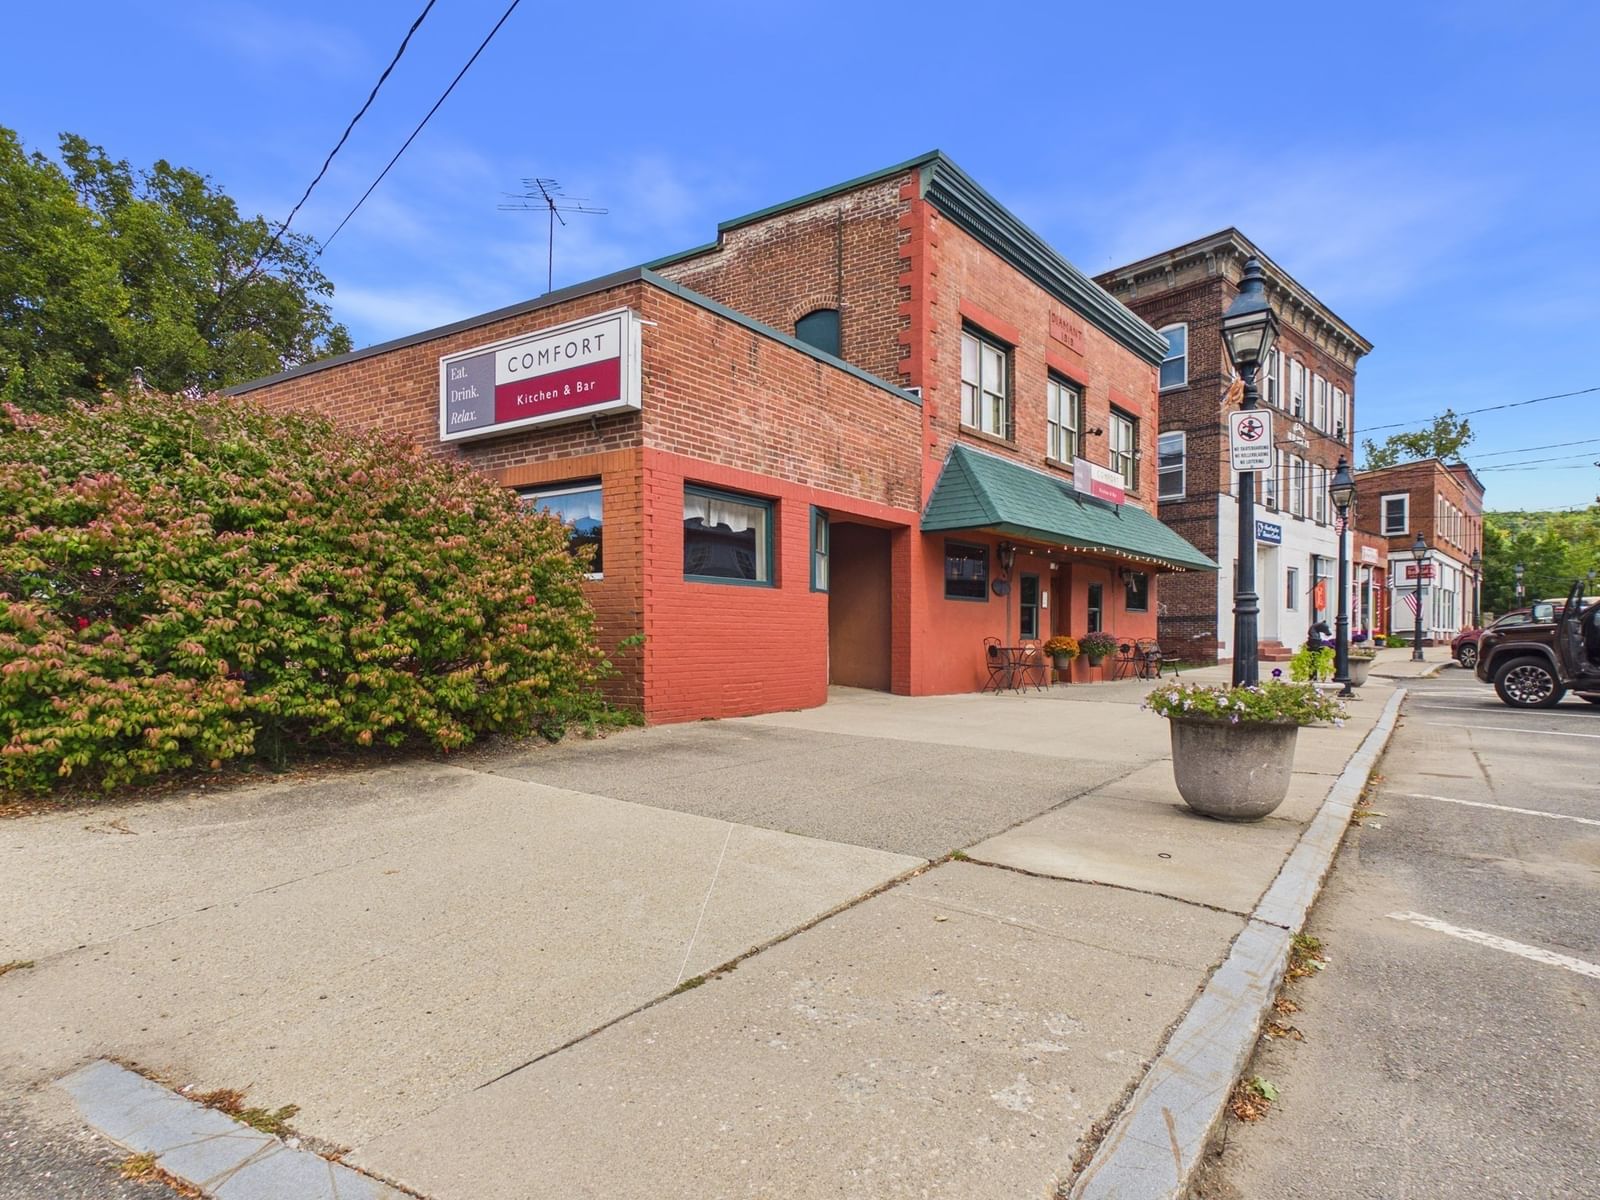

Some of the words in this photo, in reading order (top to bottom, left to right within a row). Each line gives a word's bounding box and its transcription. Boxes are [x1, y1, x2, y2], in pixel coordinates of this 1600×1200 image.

[508, 334, 604, 372] COMFORT
[450, 366, 468, 381] Eat.
[450, 385, 480, 403] Drink.
[517, 390, 558, 406] Kitchen
[563, 384, 571, 396] &
[576, 380, 596, 394] Bar
[450, 408, 478, 425] Relax.
